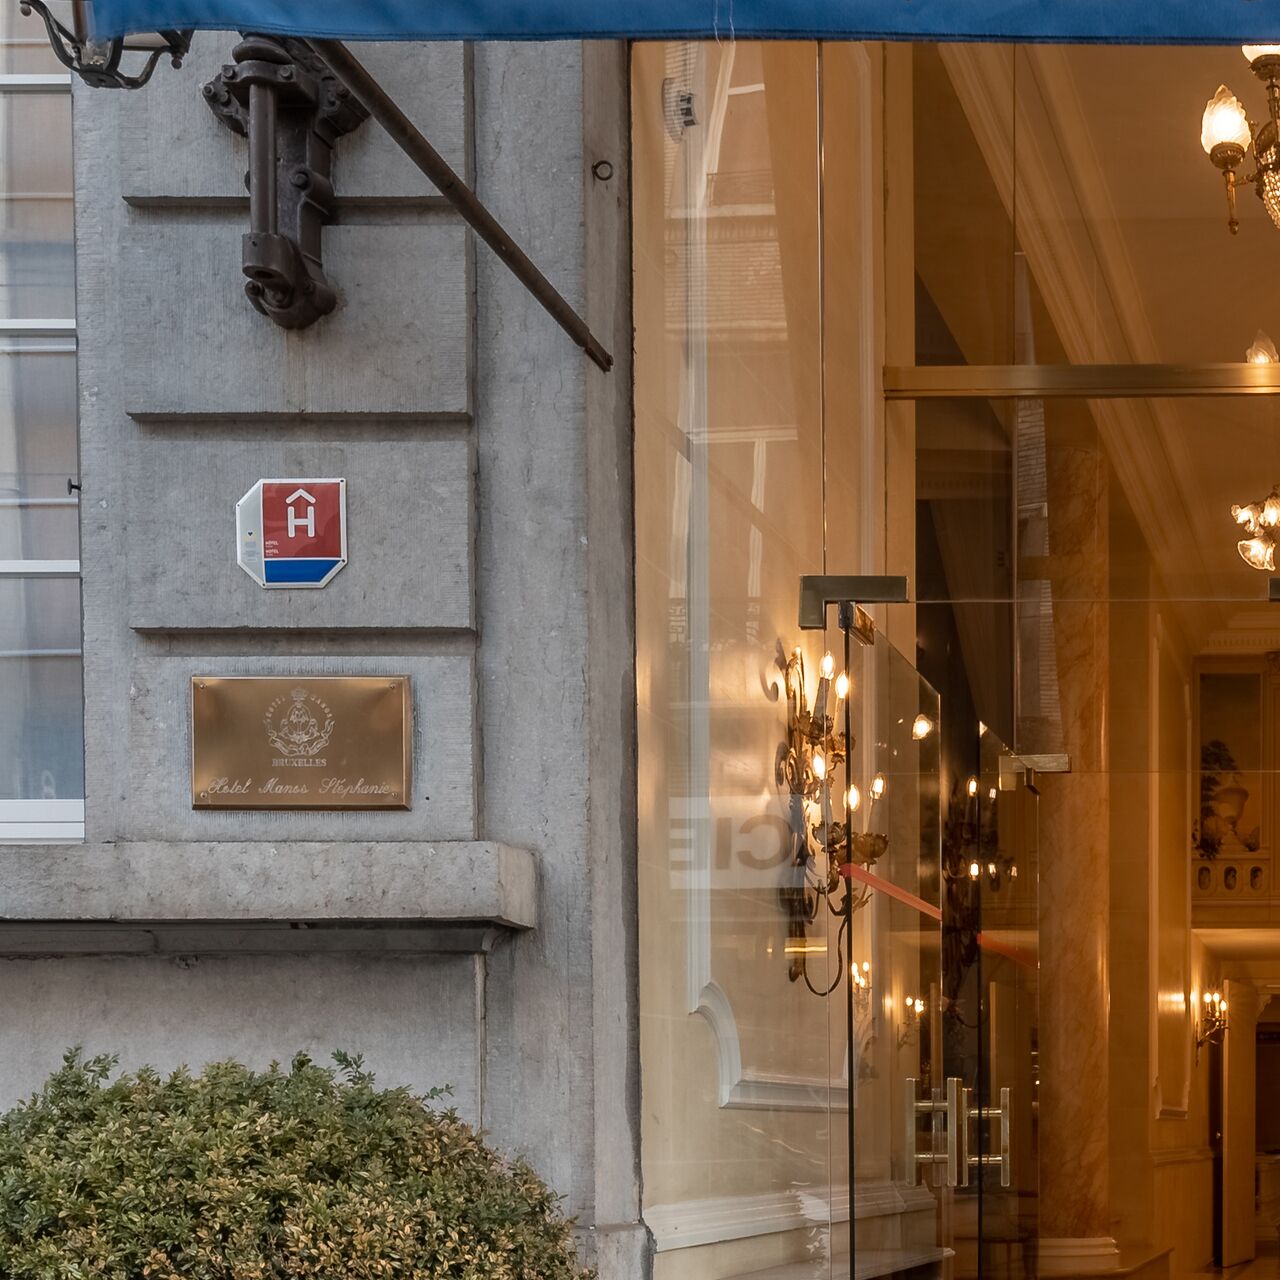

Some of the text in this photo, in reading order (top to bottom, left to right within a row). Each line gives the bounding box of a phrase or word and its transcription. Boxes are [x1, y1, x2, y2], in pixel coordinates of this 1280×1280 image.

[272, 758, 327, 767] BRUXELLES
[207, 776, 252, 794] Hotel
[258, 777, 309, 794] Manos
